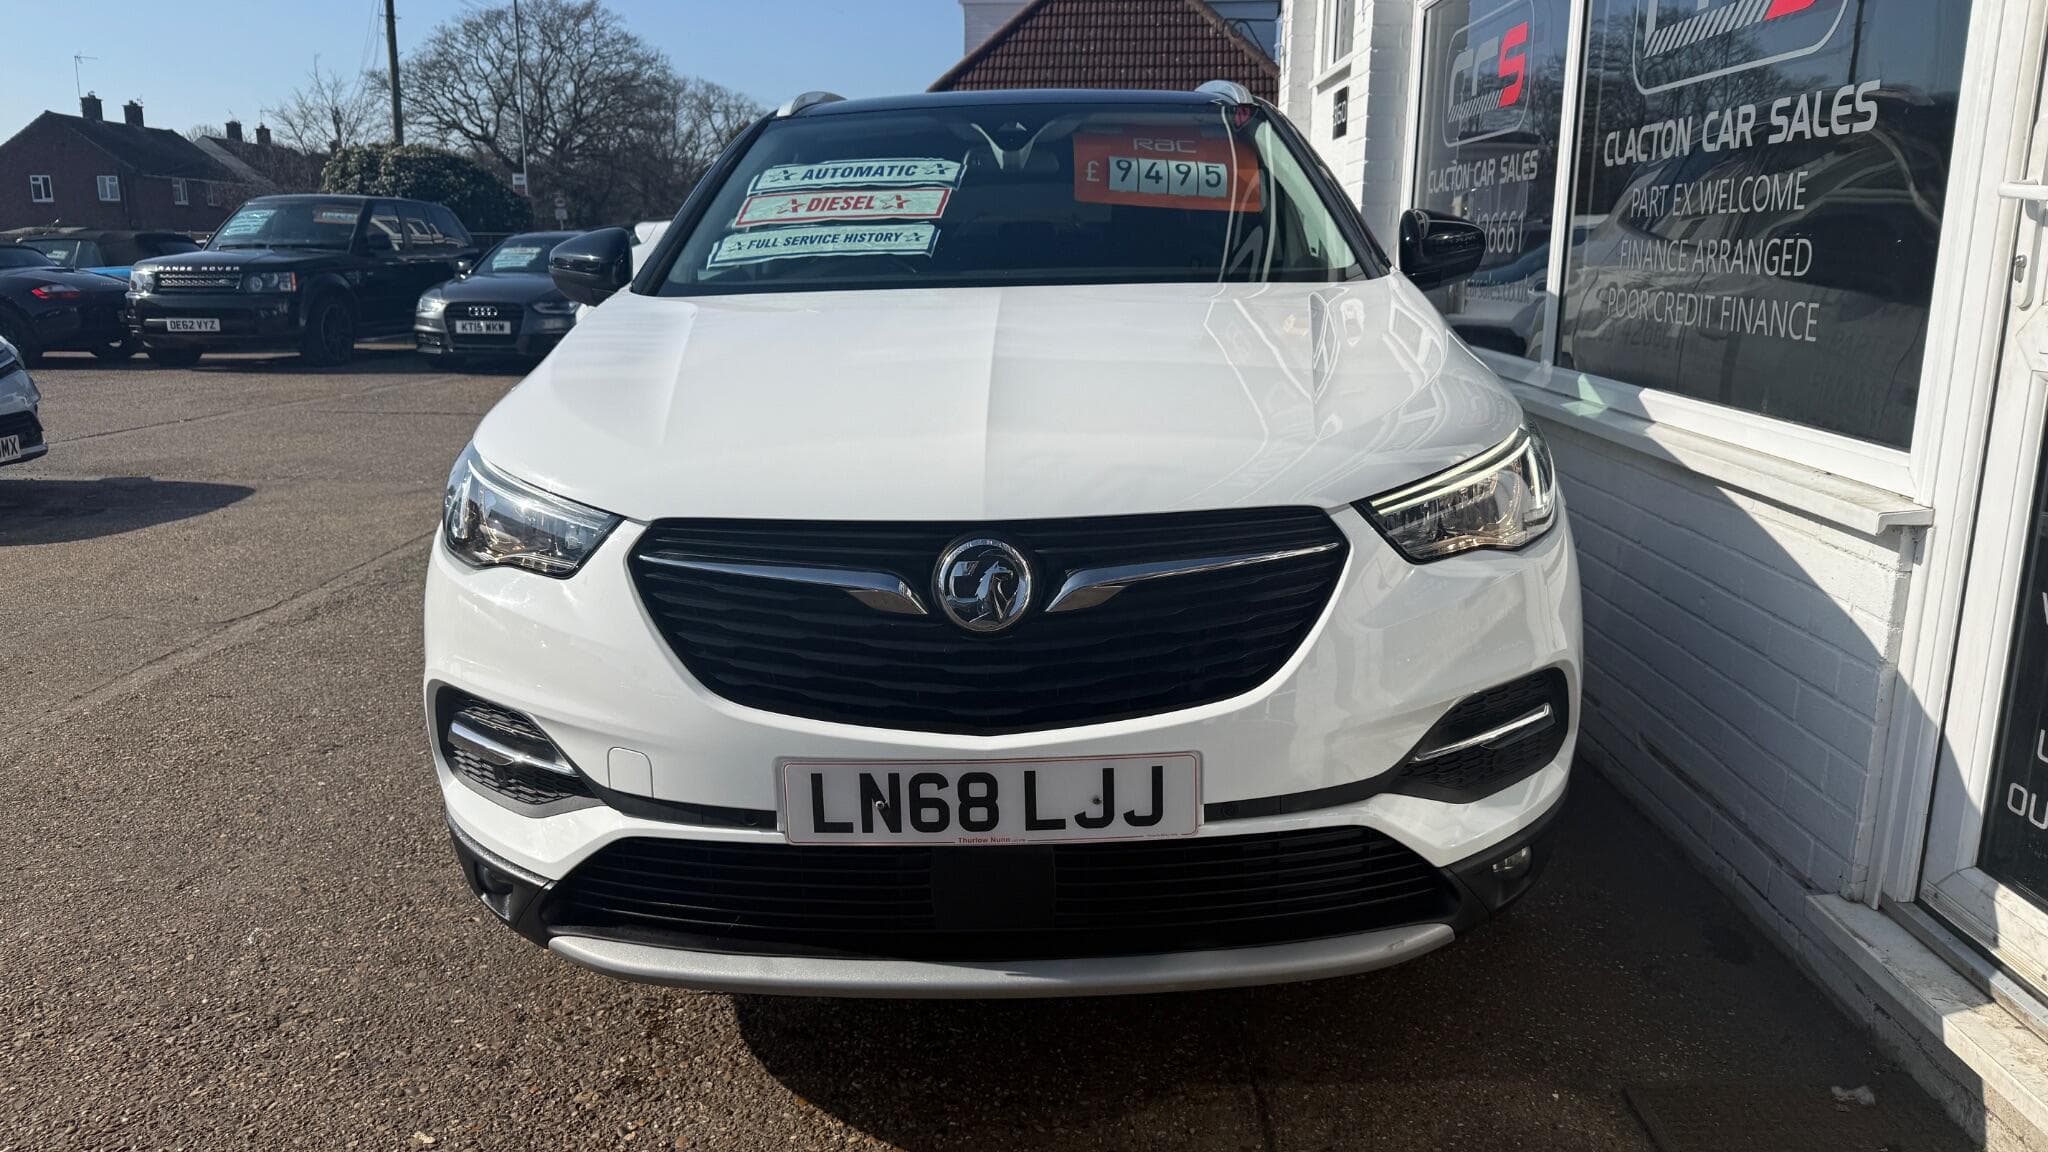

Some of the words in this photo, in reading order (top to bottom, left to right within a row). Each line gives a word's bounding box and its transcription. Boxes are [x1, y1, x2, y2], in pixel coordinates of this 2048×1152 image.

[1603, 115, 1693, 168] CLACTON
[1702, 103, 1757, 153] CAR
[1768, 79, 1881, 145] SALES
[801, 164, 919, 181] AUTOMATIC
[1427, 162, 1471, 194] CLACTON
[1474, 158, 1496, 187] CAR
[1500, 149, 1540, 185] SALES
[805, 195, 876, 212] DIESEL
[1630, 184, 1670, 219] PART
[1672, 181, 1696, 216] EX
[1700, 170, 1809, 215] WELCOME
[747, 238, 779, 250] FULL
[783, 233, 840, 247] SERVICE
[843, 232, 904, 243] HISTORY
[1476, 209, 1524, 254] 26661
[1619, 238, 1689, 272] FINANCE
[1691, 237, 1813, 277] ARRANGED
[169, 320, 195, 330] OE62
[197, 320, 216, 330] VYZ
[1607, 287, 1649, 321] POOR
[1653, 290, 1716, 329] CREDIT
[1720, 295, 1821, 343] FINANCE
[0, 437, 18, 458] MX
[810, 771, 999, 834] LN68
[1023, 765, 1164, 831] LJJ
[958, 836, 988, 844] Thurlow
